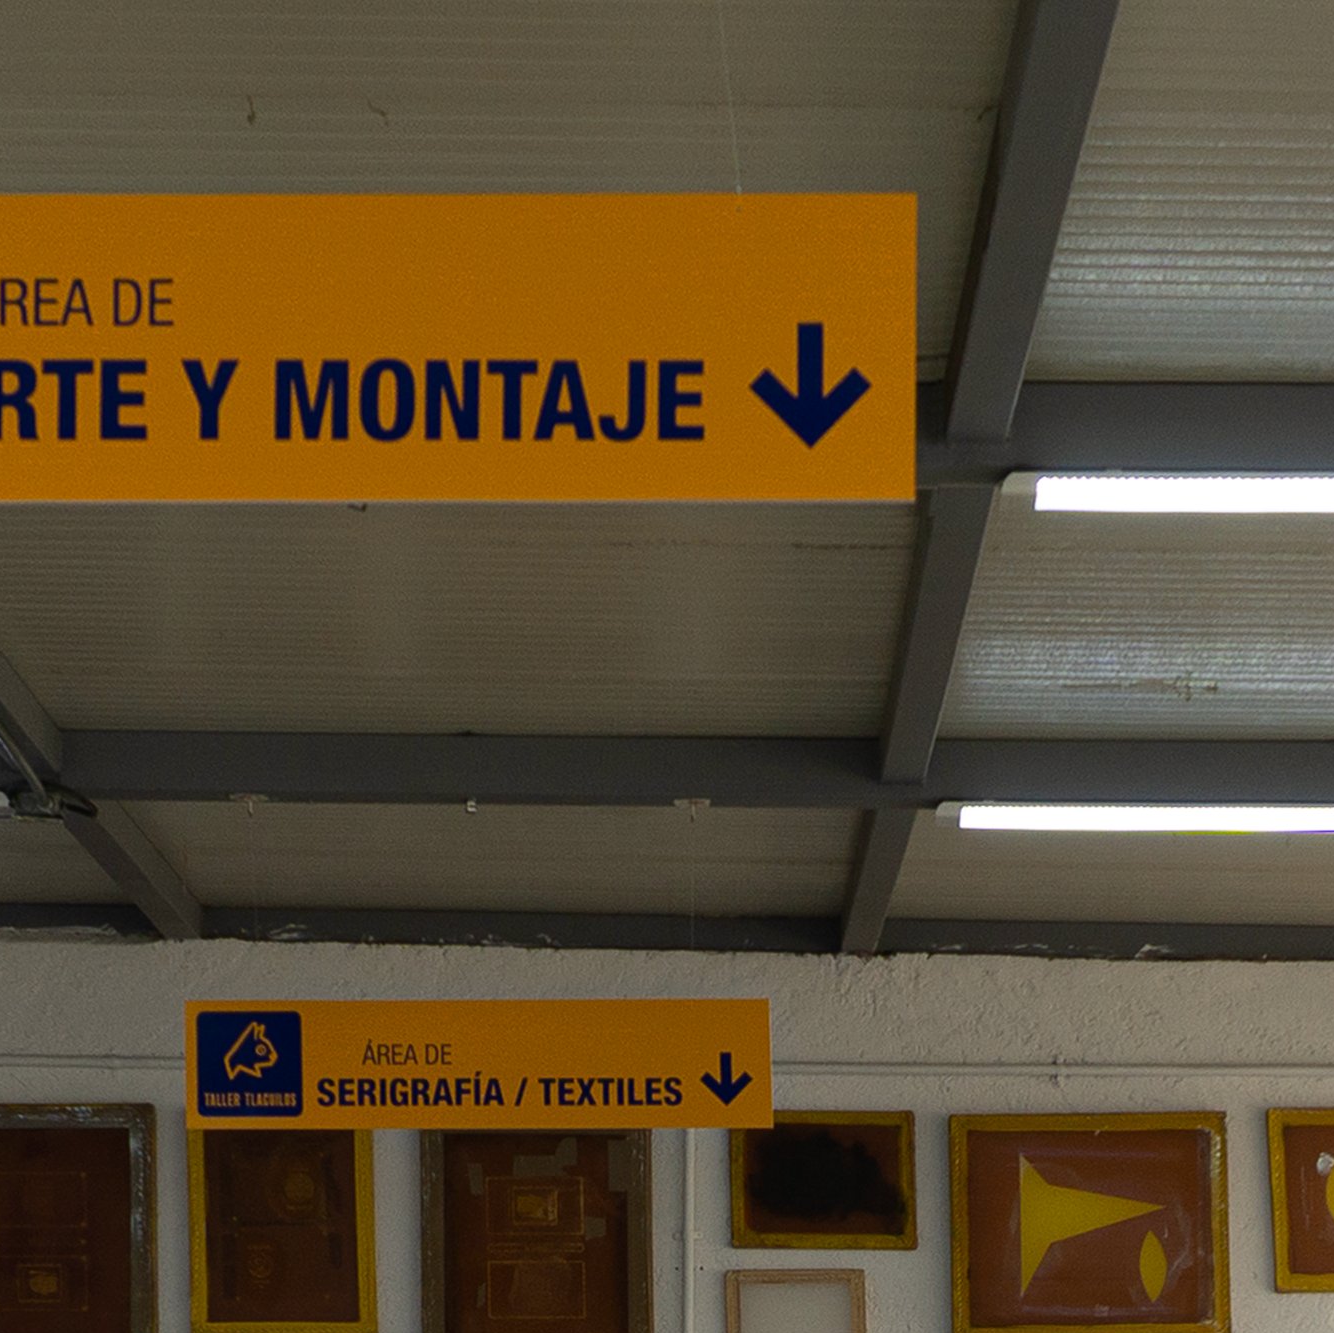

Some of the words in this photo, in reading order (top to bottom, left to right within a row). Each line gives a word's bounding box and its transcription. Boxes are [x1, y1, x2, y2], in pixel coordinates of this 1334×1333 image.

[114, 278, 175, 327] DE
[180, 359, 241, 443] Y
[272, 358, 706, 444] MONTAJE
[361, 1038, 418, 1066] ÁREA
[425, 1044, 452, 1066] DE
[204, 1091, 241, 1107] TALLER
[316, 1071, 505, 1108] SERIGRAFÍA
[538, 1076, 683, 1107] TEXTILES
